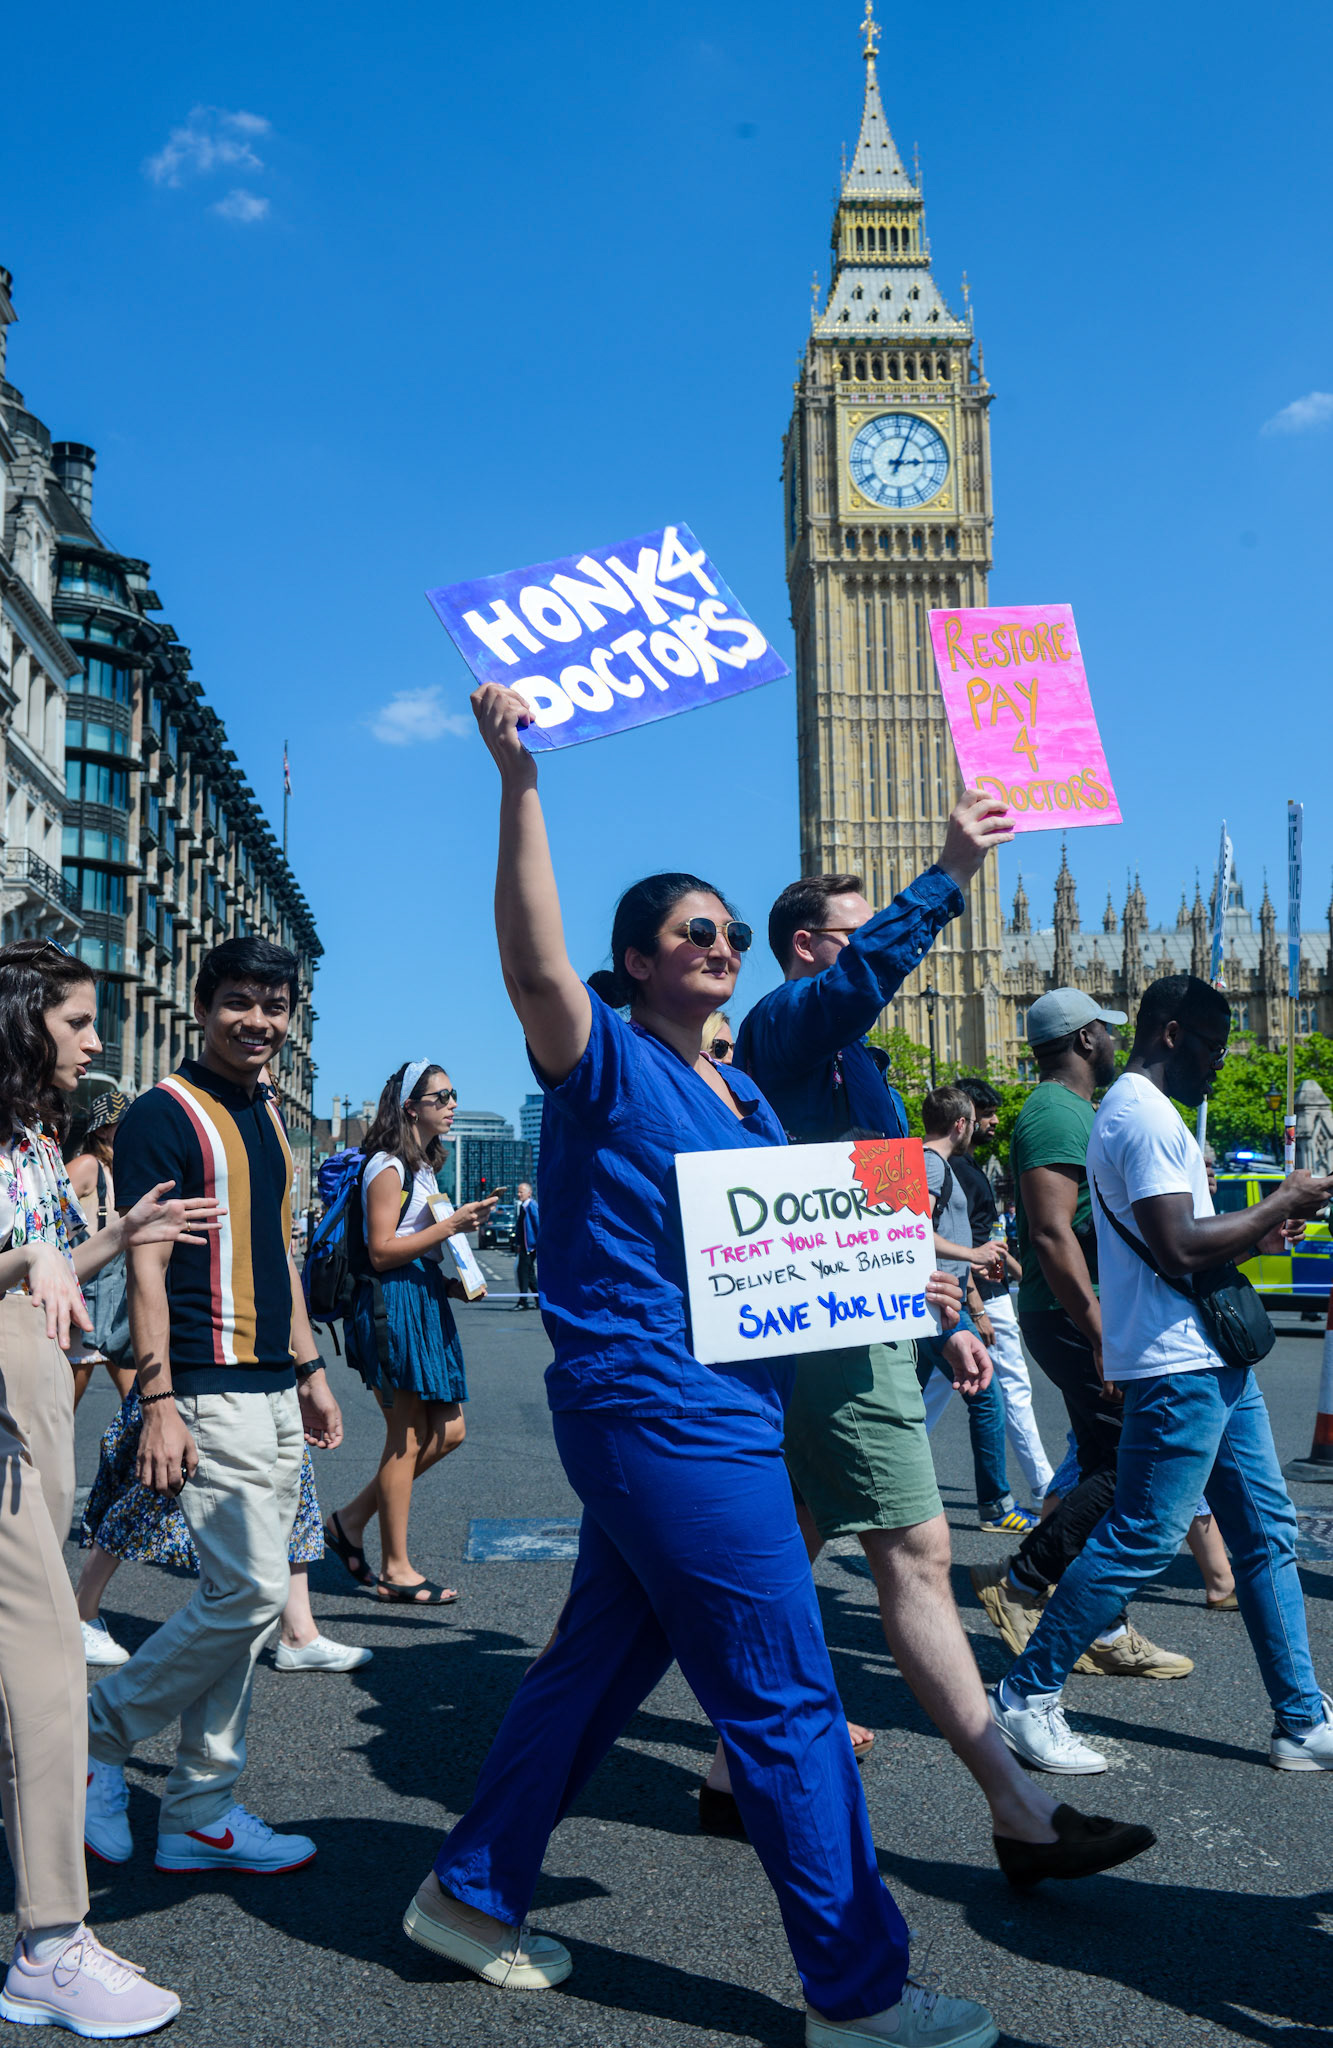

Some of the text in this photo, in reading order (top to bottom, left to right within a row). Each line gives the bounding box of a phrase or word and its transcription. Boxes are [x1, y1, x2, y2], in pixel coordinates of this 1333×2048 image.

[509, 599, 767, 728] DOCTORS
[944, 616, 1072, 672] RESTORE
[966, 676, 1038, 730] PAY
[1012, 725, 1039, 773] 4
[975, 768, 1110, 812] DOCTORS
[873, 1147, 912, 1194] 26%
[896, 1178, 922, 1205] OFF
[701, 1224, 926, 1268] TREAT YOUR LOVED ONES
[708, 1250, 915, 1296] DELIVER YOUR BABIES
[738, 1291, 927, 1339] SAVE YOUR LIFE
